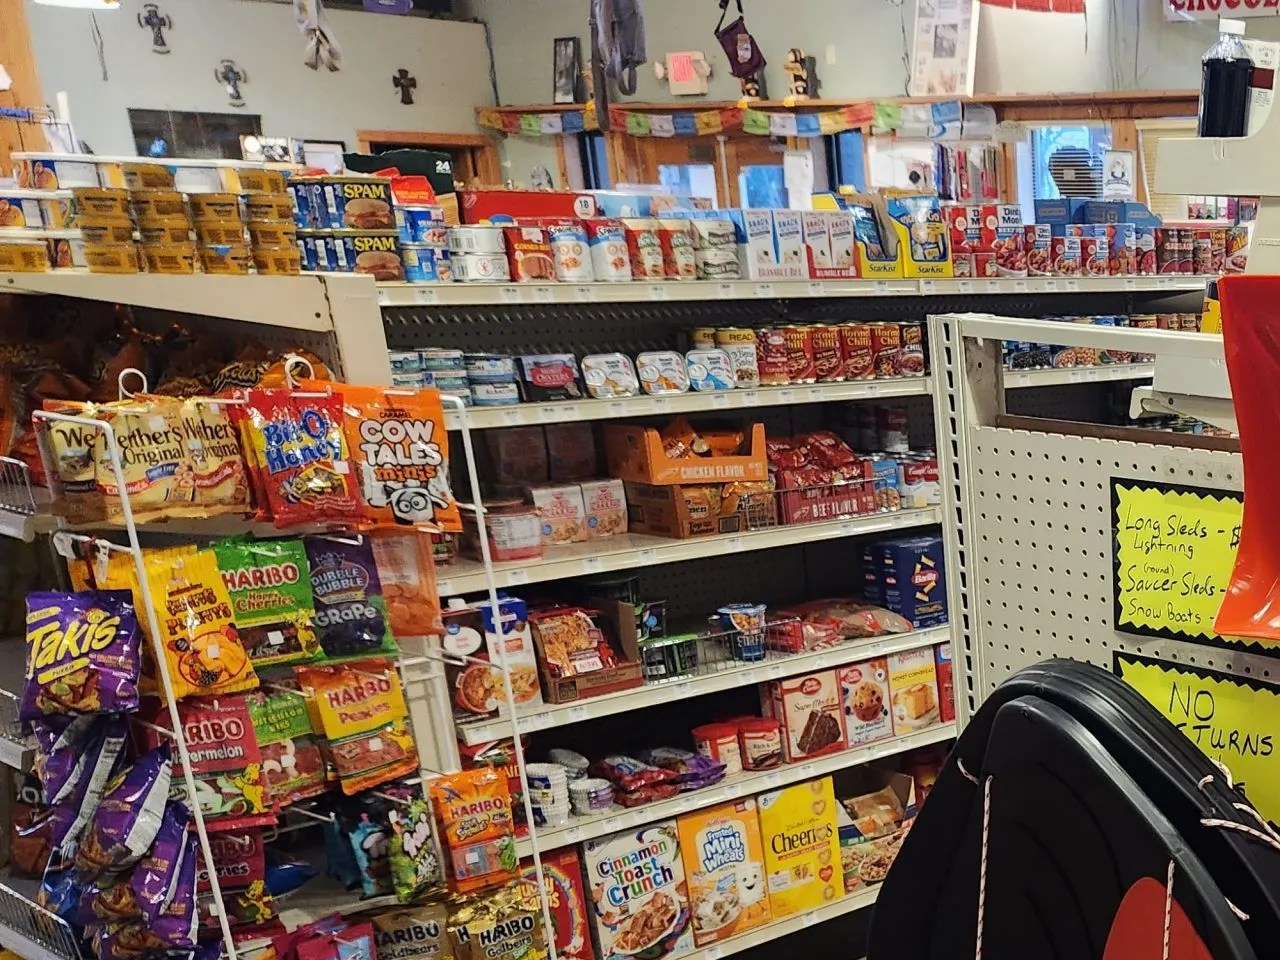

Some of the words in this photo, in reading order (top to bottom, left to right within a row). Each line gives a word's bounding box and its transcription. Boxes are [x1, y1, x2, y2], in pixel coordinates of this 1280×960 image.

[436, 161, 450, 171] 24
[344, 184, 385, 199] SPAM
[579, 200, 590, 209] 18
[1002, 216, 1021, 225] Moo
[355, 237, 396, 251] SPAM
[870, 264, 896, 272] StarKist
[918, 265, 944, 273] StarKist
[729, 334, 752, 342] READ
[359, 419, 434, 443] COW
[123, 441, 185, 466] Original
[359, 442, 442, 466] TALES
[374, 466, 437, 482] minis
[681, 465, 715, 478] CHICKEN
[716, 464, 745, 477] FLAVOR
[1125, 504, 1161, 537] Long
[1167, 514, 1208, 538] Sleds
[1133, 534, 1194, 559] Lightning
[222, 563, 298, 589] HARIBO
[1126, 565, 1178, 593] Saucer
[1180, 572, 1216, 597] Sleds
[1143, 564, 1175, 577] (round)
[316, 577, 364, 596] BUBBLE
[236, 595, 294, 613] Cherries
[1128, 598, 1162, 619] Snow
[1167, 602, 1202, 623] Boats
[26, 616, 121, 680] Takis
[327, 679, 391, 709] HARBO
[1169, 681, 1215, 722] NO
[1175, 723, 1273, 757] TURNS
[450, 799, 503, 820] HARIBO
[707, 827, 733, 840] Frosted
[599, 840, 667, 876] Cinnamon
[705, 850, 744, 872] Wheats
[615, 858, 659, 886] Toast
[608, 866, 673, 905] Crunch
[479, 915, 534, 947] HARIBO
